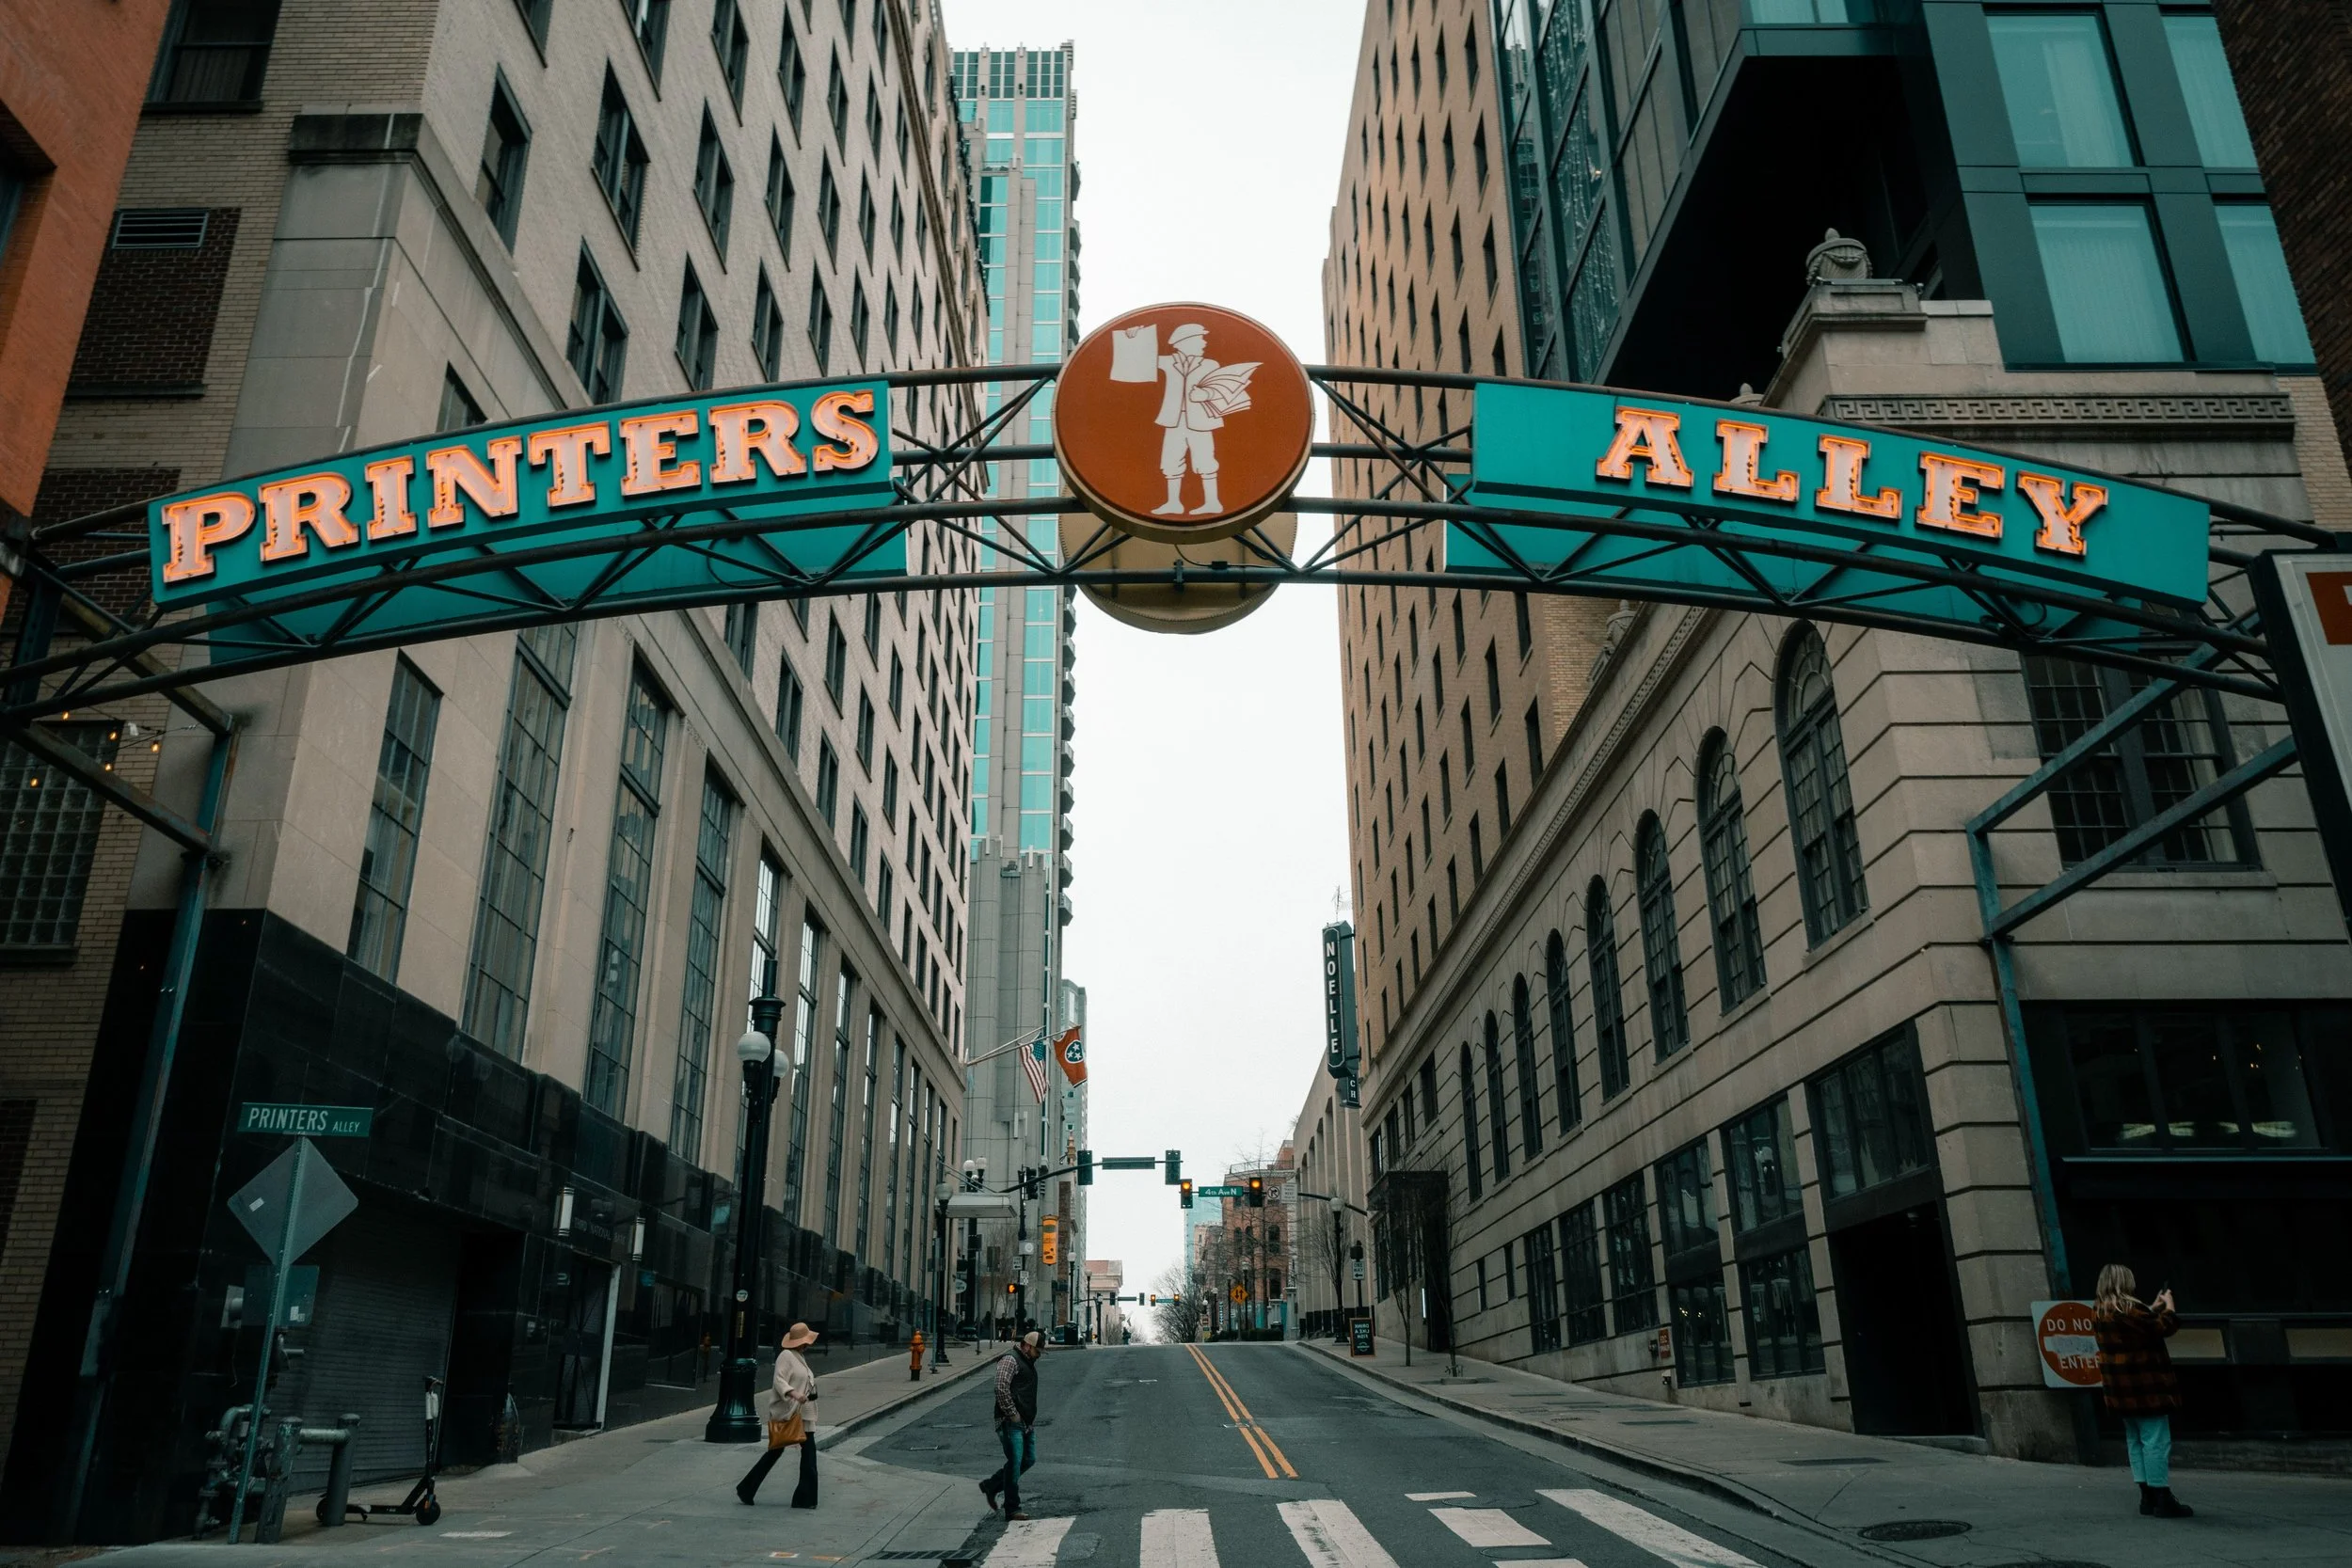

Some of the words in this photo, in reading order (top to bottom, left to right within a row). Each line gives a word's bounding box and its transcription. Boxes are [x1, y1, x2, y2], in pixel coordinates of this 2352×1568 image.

[160, 388, 880, 585] PRINTERS
[1596, 405, 2109, 560] ALLEY
[1326, 942, 1339, 1054] NOELLE
[247, 1108, 328, 1131] PRINTERS
[332, 1121, 360, 1132] ALLEY
[2046, 1318, 2066, 1332] DO
[2073, 1318, 2092, 1332] NO
